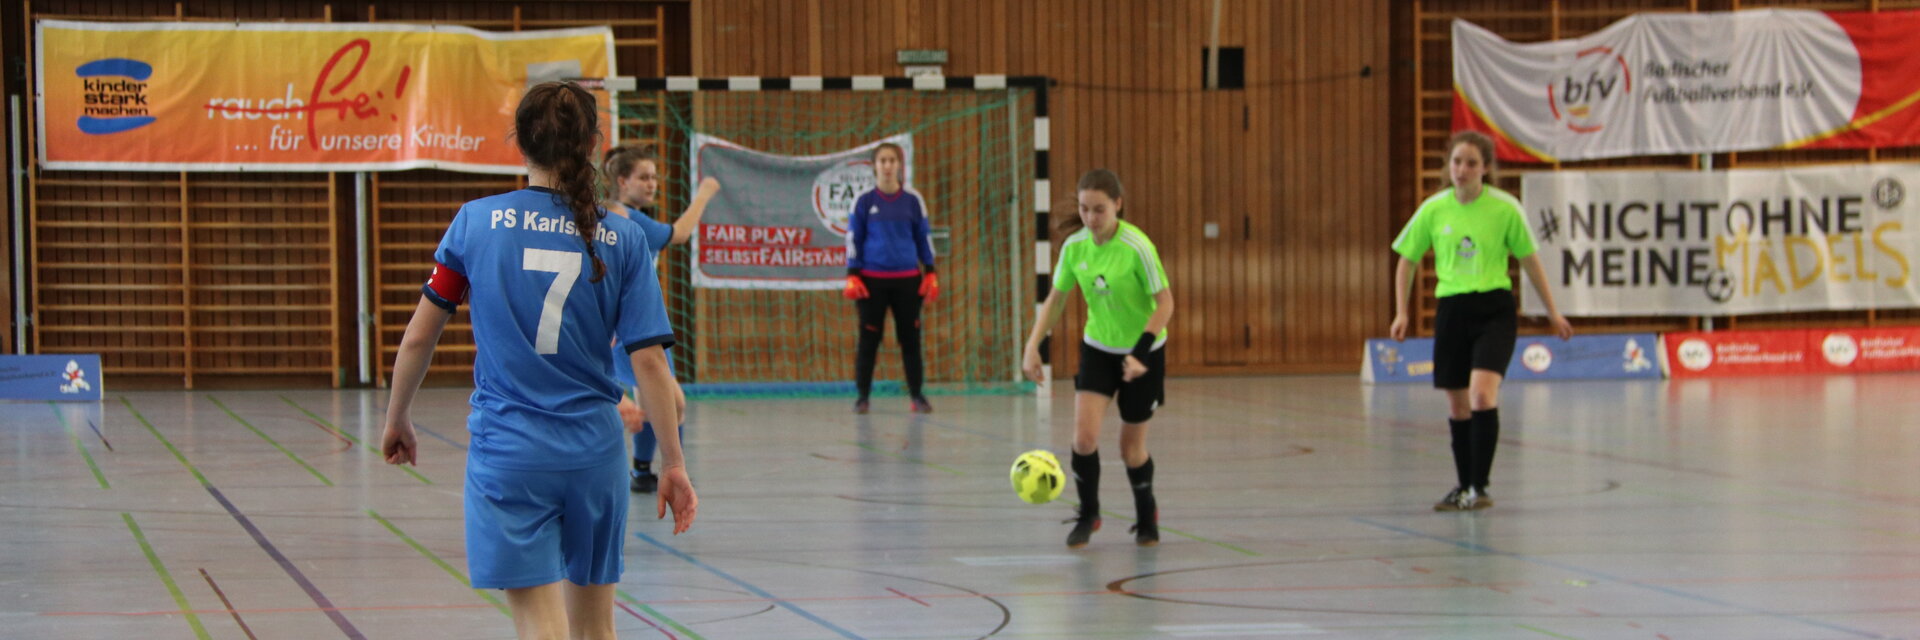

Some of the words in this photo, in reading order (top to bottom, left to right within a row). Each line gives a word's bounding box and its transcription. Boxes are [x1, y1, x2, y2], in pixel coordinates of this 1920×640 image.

[84, 79, 147, 92] kinder
[84, 92, 147, 105] stark
[1564, 71, 1617, 104] bfv
[84, 105, 148, 116] machen
[208, 82, 304, 120] rauch
[269, 124, 304, 150] für
[320, 131, 402, 150] unsere
[410, 124, 486, 152] Kinder
[491, 208, 517, 230] PS
[523, 210, 618, 246] Karlshe
[705, 224, 747, 242] FAIR
[751, 226, 807, 244] PLAY?
[705, 246, 848, 266] SELBSTFAIRSTÄN
[1562, 249, 1711, 288] MEINE
[1714, 221, 1911, 297] MÄDELS
[523, 247, 583, 355] 7
